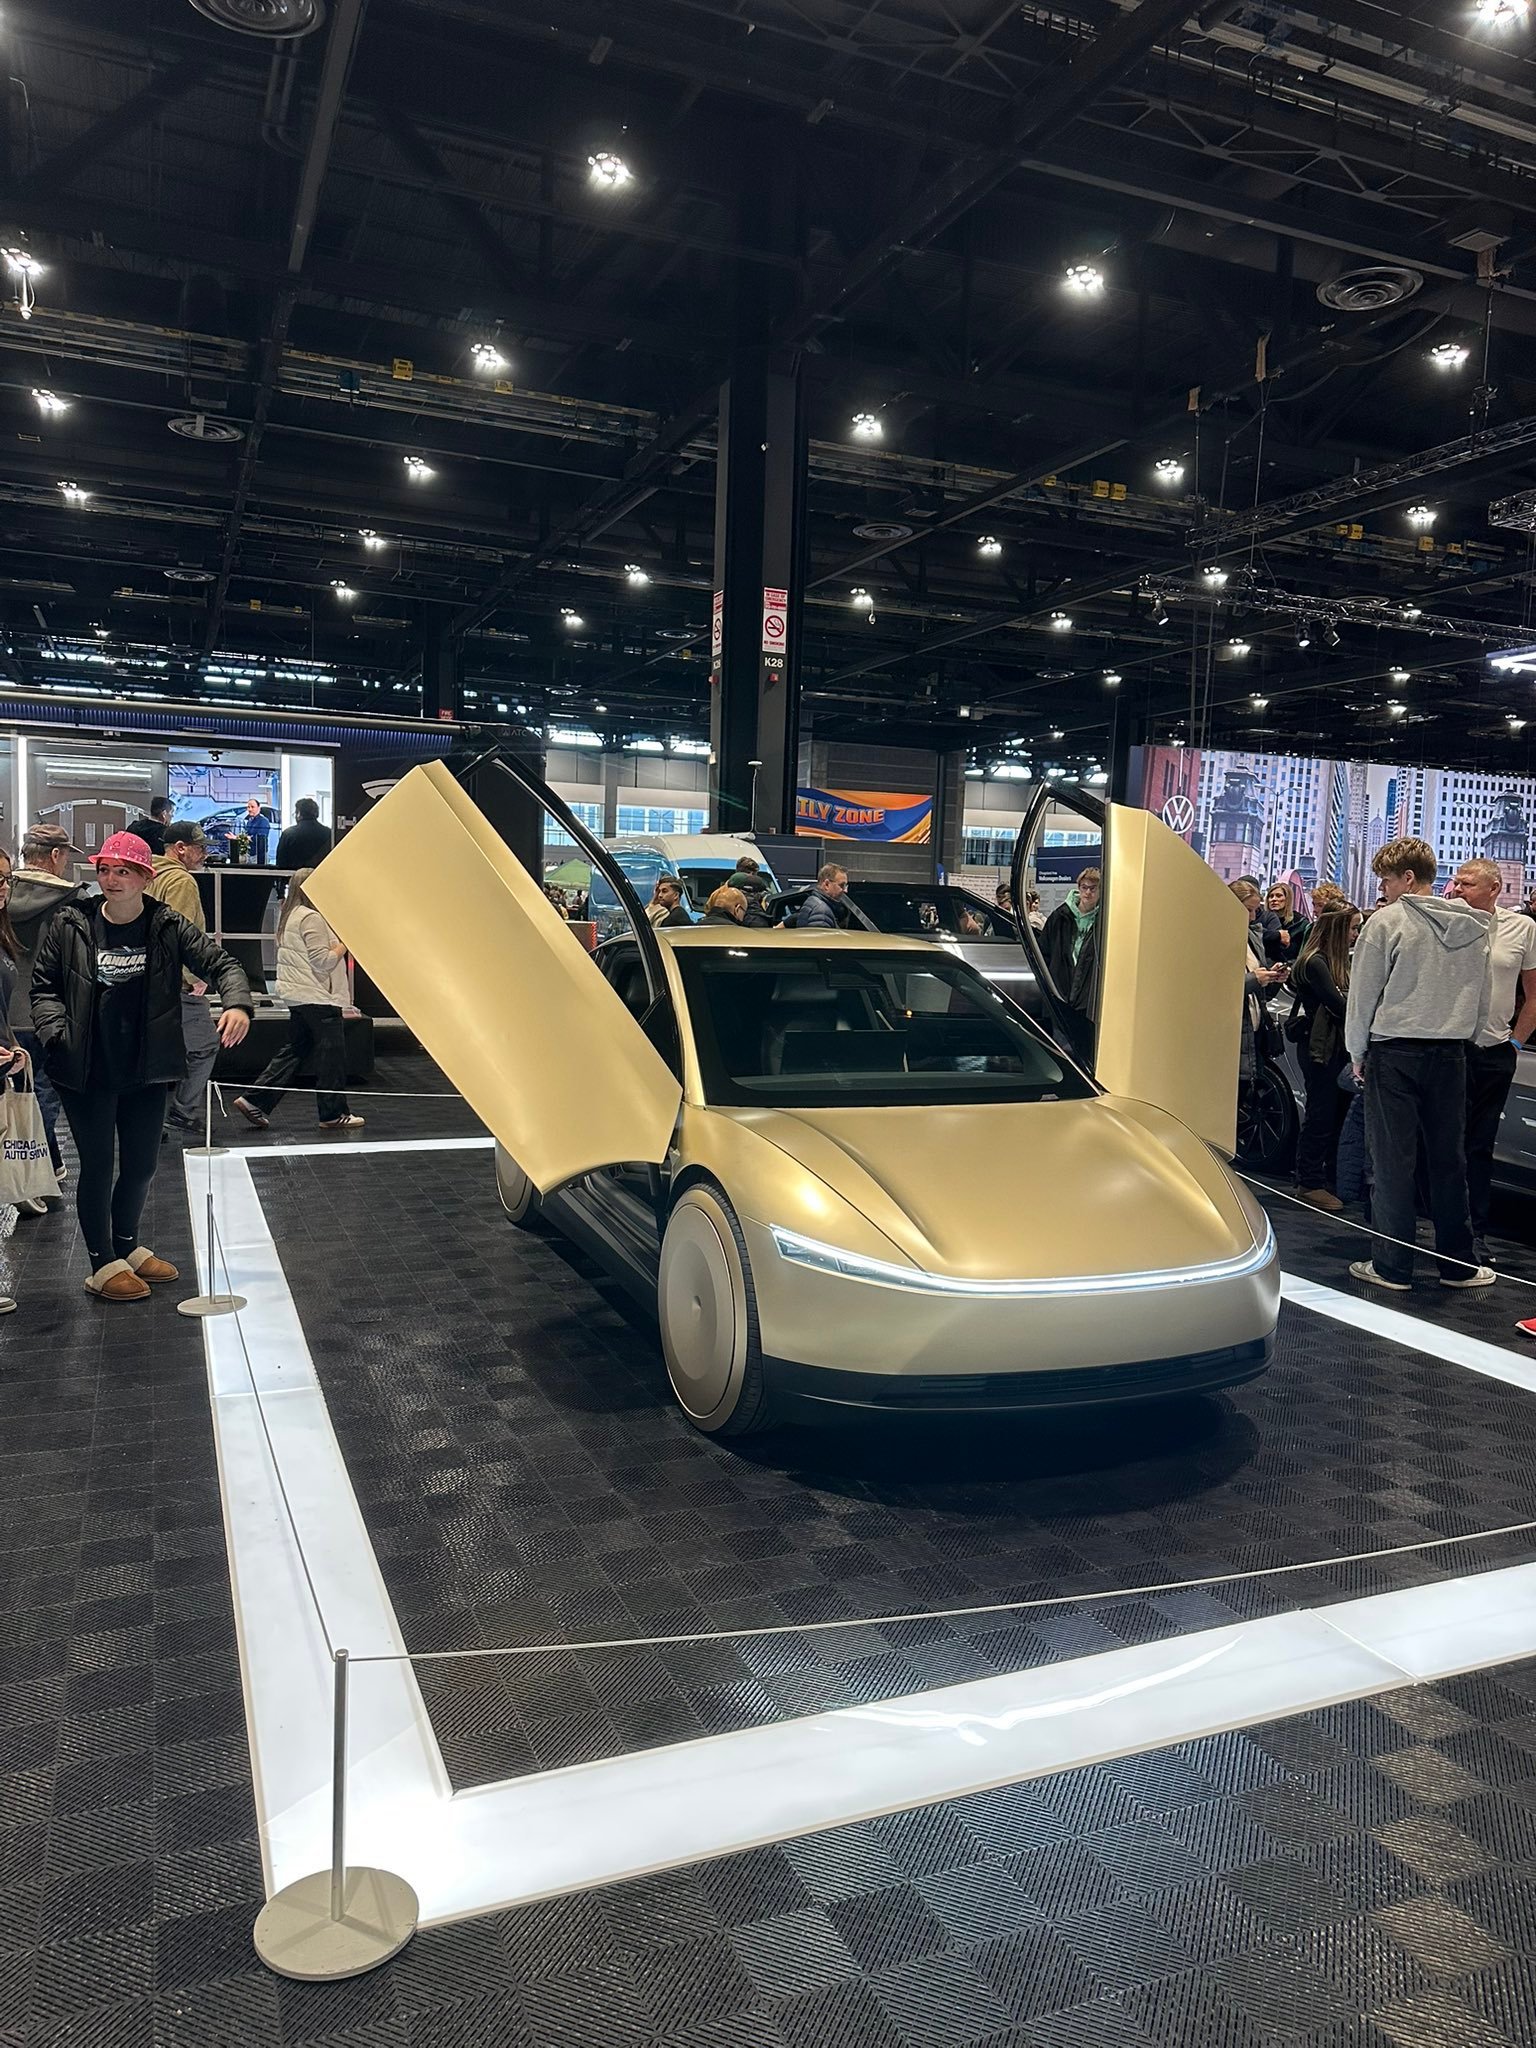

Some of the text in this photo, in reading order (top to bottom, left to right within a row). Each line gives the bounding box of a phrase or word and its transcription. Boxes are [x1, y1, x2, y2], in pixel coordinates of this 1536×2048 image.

[764, 657, 784, 668] K28
[834, 805, 885, 825] ZONE
[5, 1150, 27, 1160] AUTO
